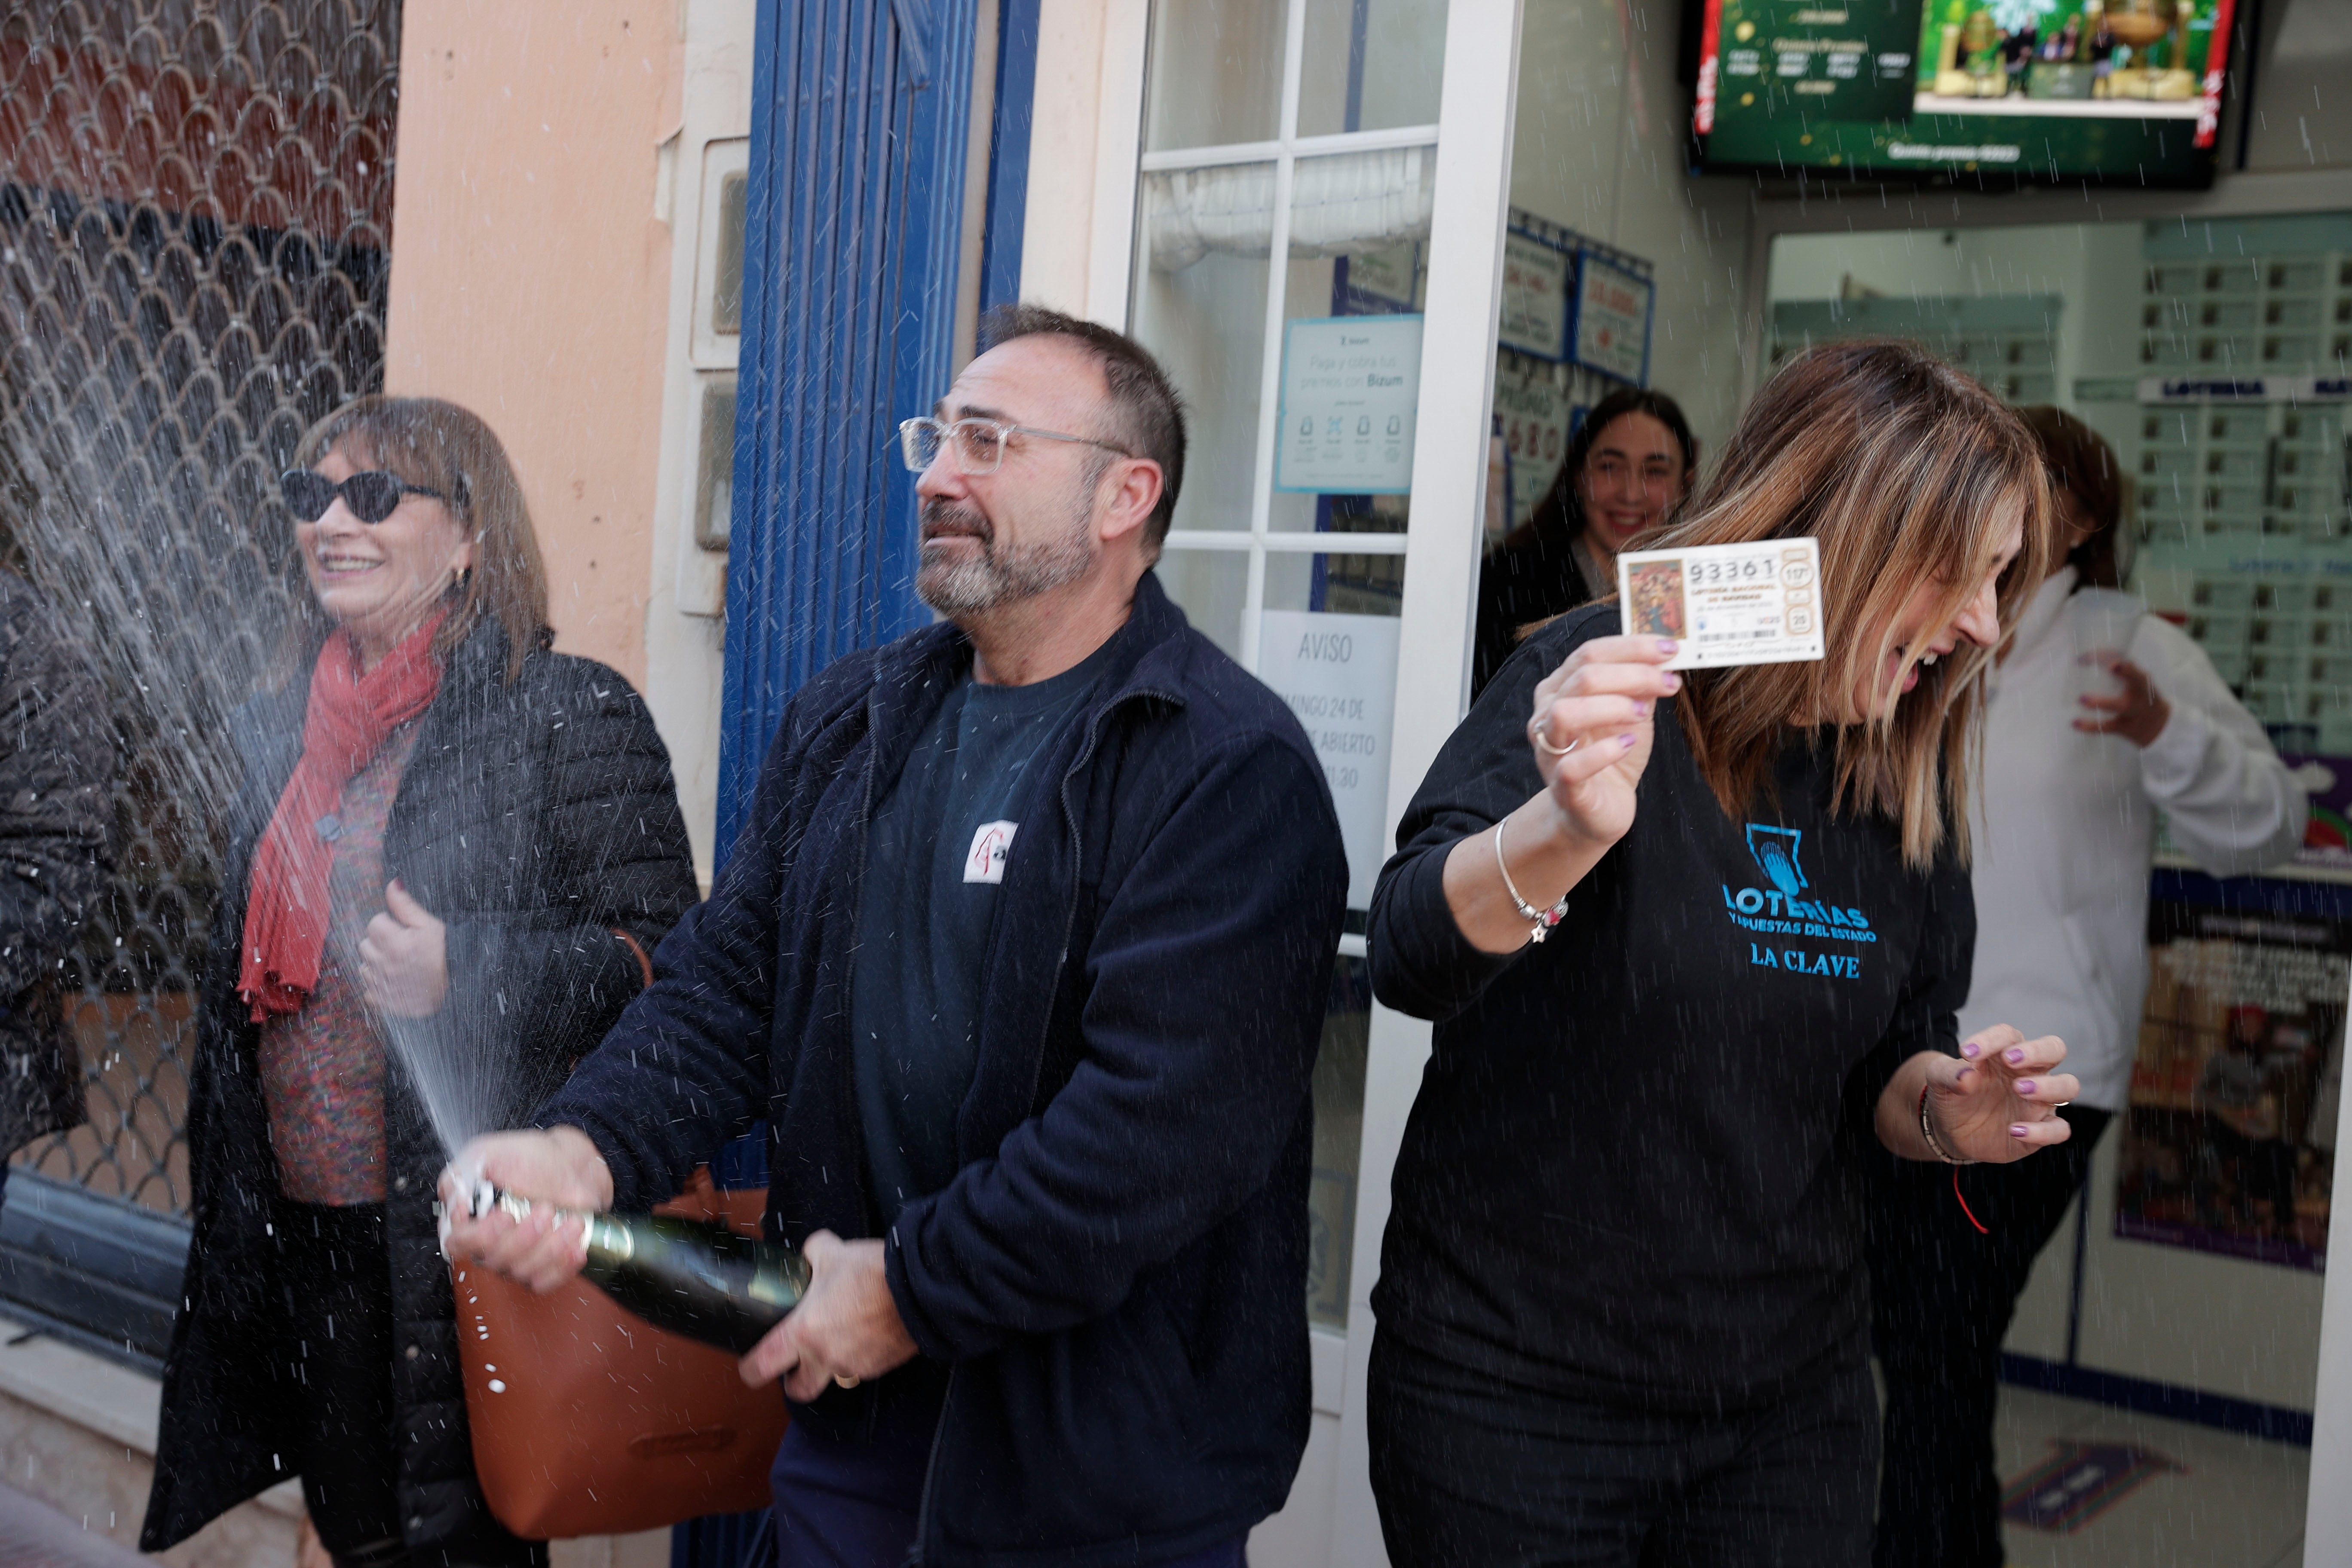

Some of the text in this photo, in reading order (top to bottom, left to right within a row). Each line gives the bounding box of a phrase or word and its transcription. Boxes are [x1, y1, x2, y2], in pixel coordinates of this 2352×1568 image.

[1310, 355, 1335, 371] Paga
[1338, 359, 1346, 371] y
[1348, 356, 1376, 368] cobra
[1367, 373, 1403, 387] Bizum
[1690, 559, 1774, 582] 93361
[1285, 694, 1364, 720] MINGO 24 DE
[1804, 922, 1830, 937] DEL
[1830, 926, 1877, 943] ESTADO
[1751, 943, 1860, 980] LA CLAVE
